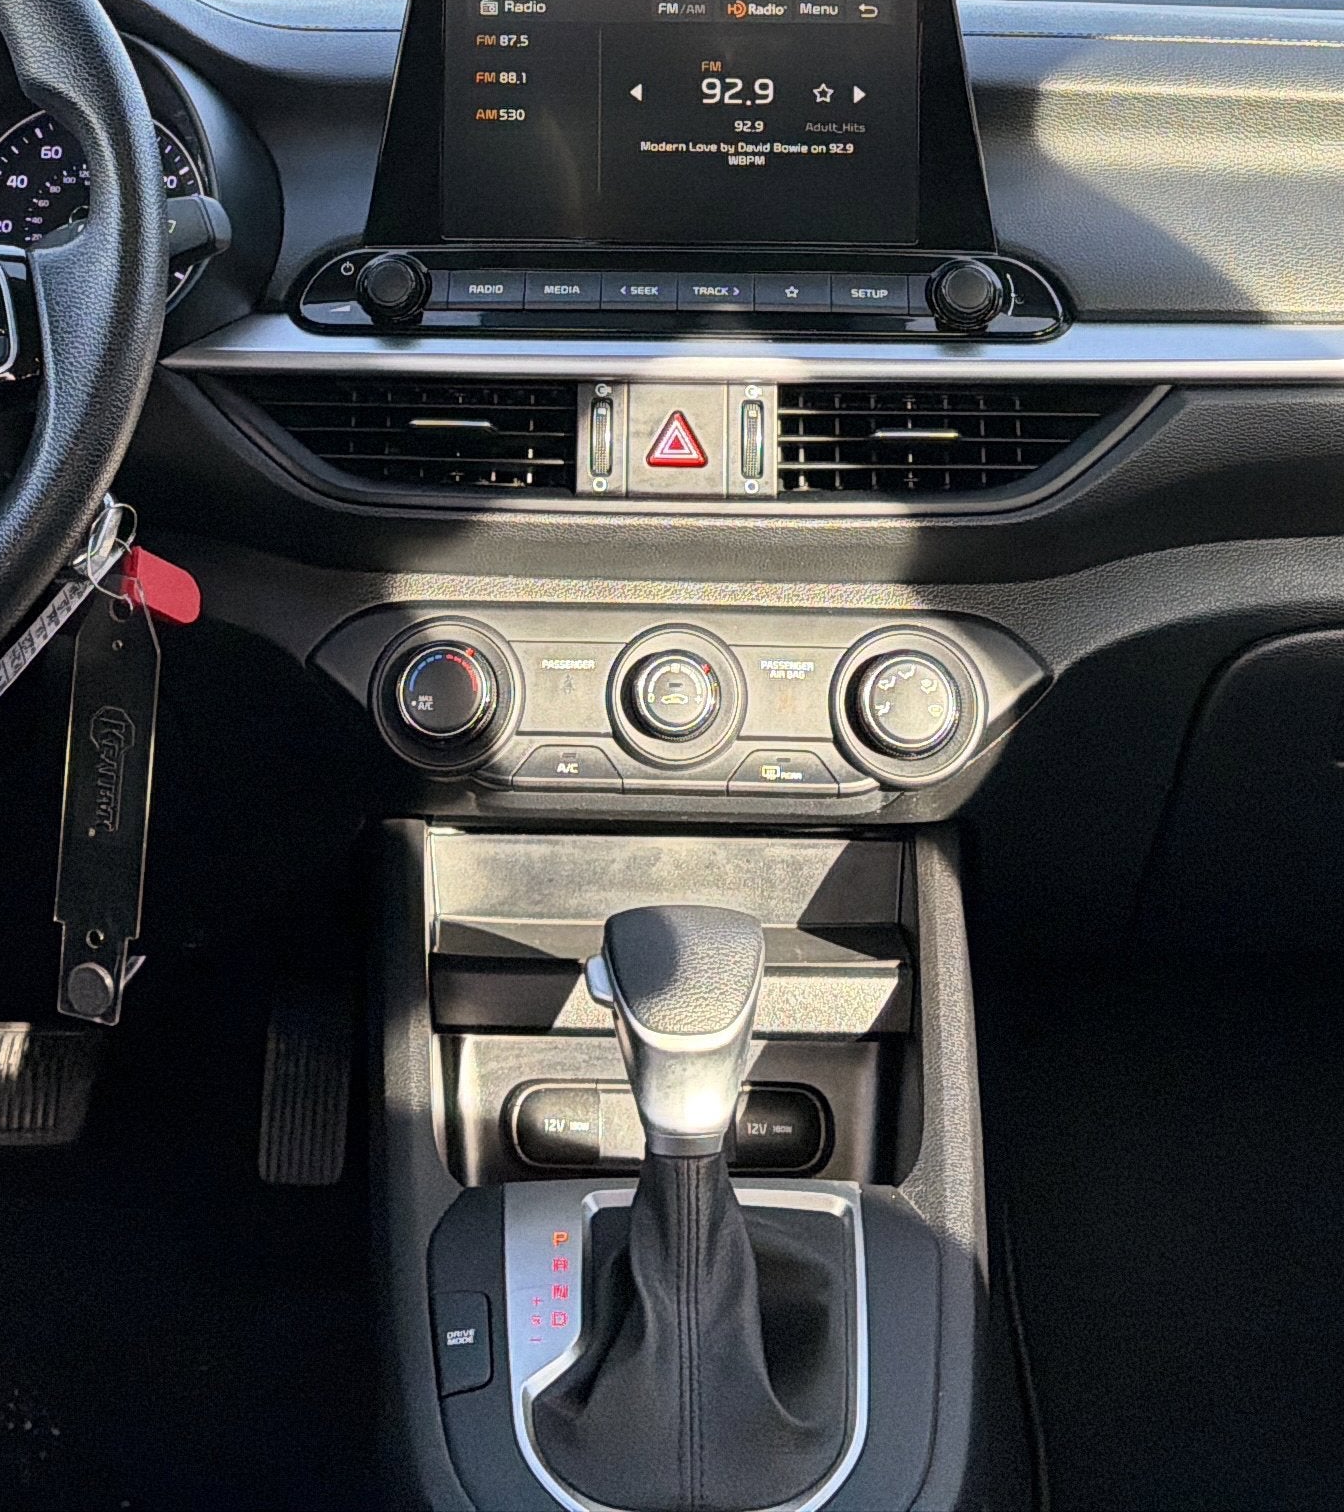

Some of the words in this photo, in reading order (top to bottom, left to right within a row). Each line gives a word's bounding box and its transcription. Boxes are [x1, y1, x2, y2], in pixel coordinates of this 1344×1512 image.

[504, 0, 547, 13] Radio
[799, 3, 839, 15] Menu
[476, 34, 496, 46] FM
[499, 34, 529, 47] 87.5
[701, 61, 722, 72] FM
[476, 72, 496, 83] FM
[499, 71, 527, 84] 88.1
[701, 77, 774, 107] 92.9
[476, 109, 497, 121] AM
[499, 109, 525, 121] 530
[734, 120, 764, 133] 92.9
[40, 146, 63, 160] 60
[640, 141, 686, 153] Modern
[689, 142, 718, 153] Love
[720, 142, 736, 155] by
[737, 142, 771, 154] David
[773, 142, 808, 155] Bowie
[810, 144, 827, 155] on
[829, 143, 855, 155] 92.9
[728, 155, 766, 167] WBPM
[6, 174, 29, 188] 40
[62, 175, 76, 184] 100
[50, 185, 61, 194] 80
[38, 199, 50, 208] 60
[468, 284, 504, 294] RADIO
[543, 285, 580, 295] MEDIA
[630, 286, 659, 295] SEEK
[692, 286, 729, 296] TRACK
[850, 288, 889, 299] SETUP
[541, 659, 596, 670] PASSENGER
[760, 660, 815, 671] PASSENGER
[418, 702, 434, 711] A/C
[557, 763, 579, 774] A/C
[543, 1118, 566, 1132] 12V
[747, 1122, 767, 1135] 12V
[553, 1231, 569, 1246] P
[552, 1311, 568, 1328] D
[446, 1328, 476, 1338] DRIVE
[446, 1336, 475, 1346] MODE
